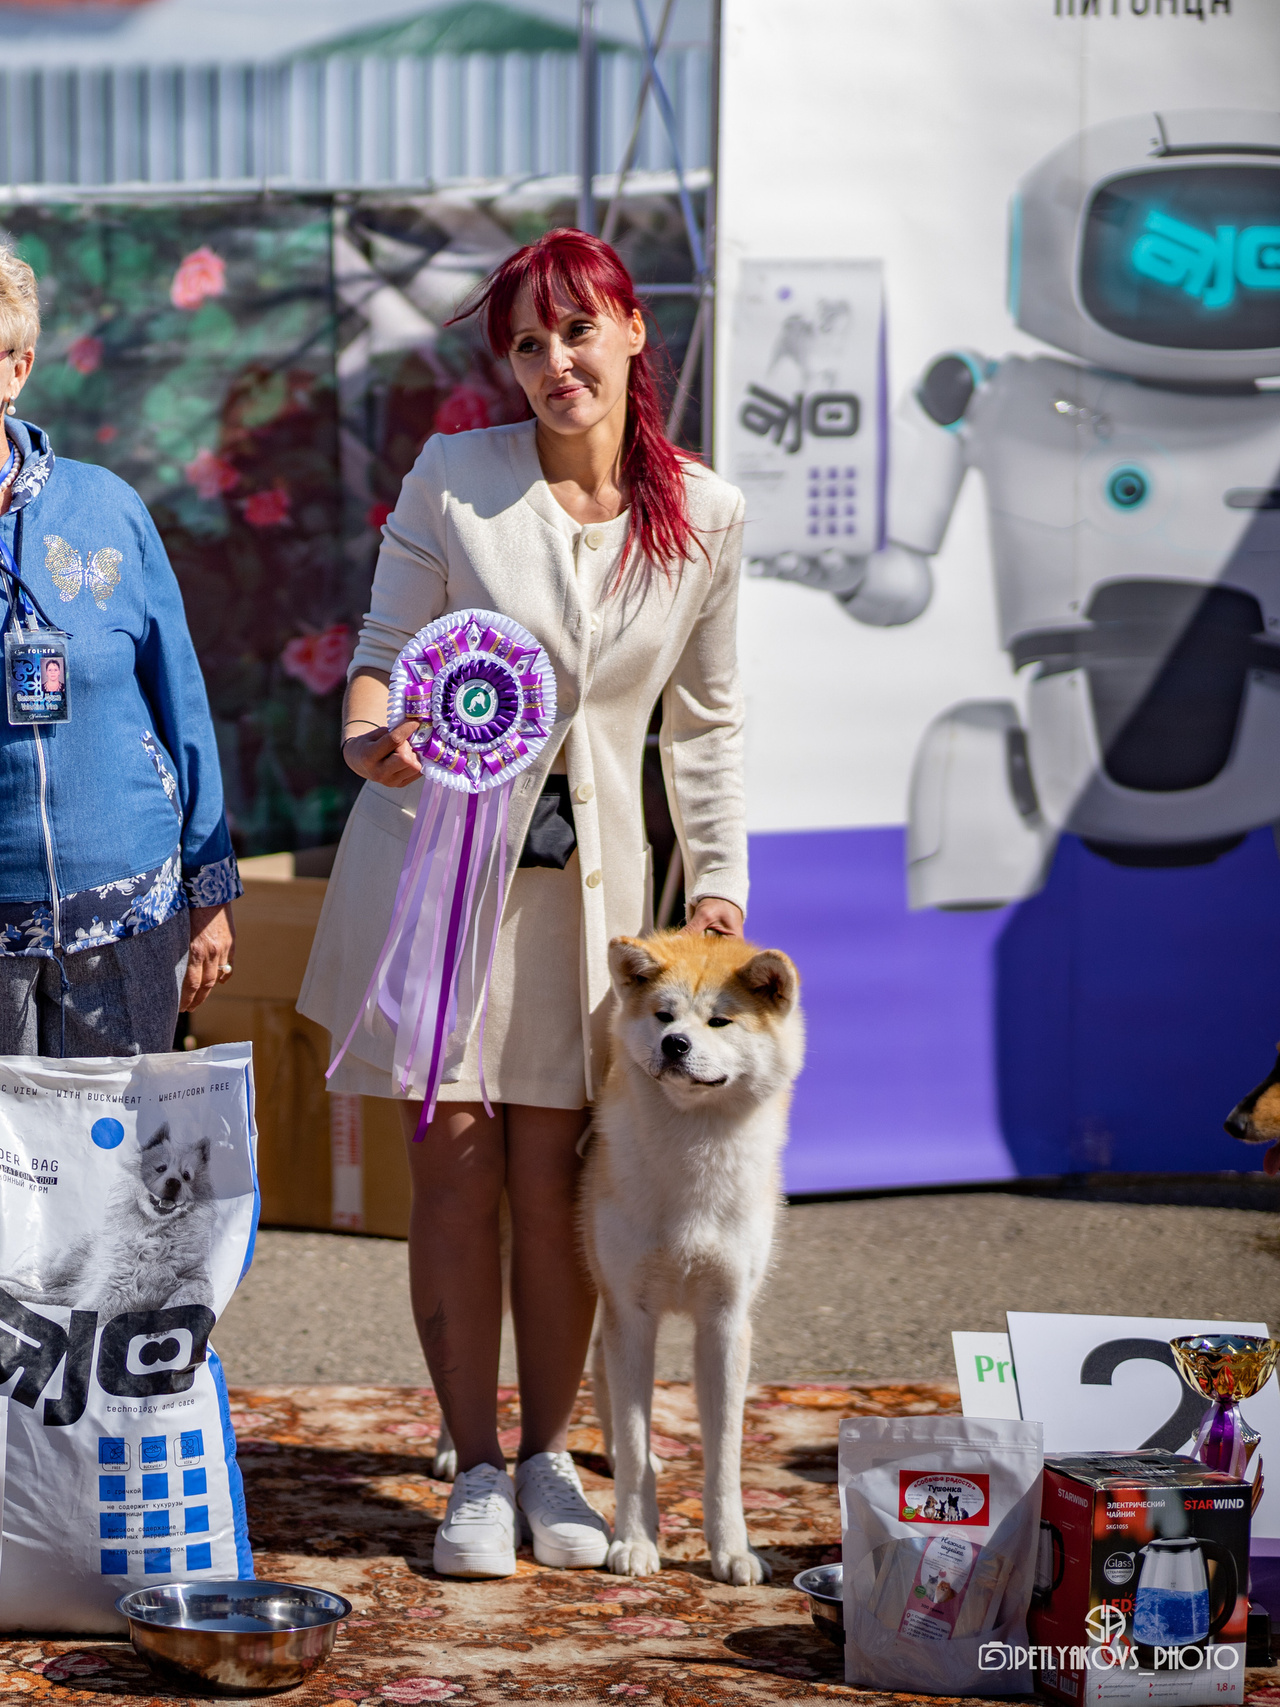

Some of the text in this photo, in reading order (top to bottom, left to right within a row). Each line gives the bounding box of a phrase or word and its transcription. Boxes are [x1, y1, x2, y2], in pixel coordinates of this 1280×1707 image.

[13, 1086, 38, 1096] VIEW
[56, 1089, 81, 1099] WITH
[87, 1092, 142, 1104] BUCKWHEAT
[158, 1086, 205, 1102] WHEAT/CORN
[210, 1082, 230, 1093] FREE
[31, 1158, 59, 1172] BAG
[1080, 1338, 1212, 1452] 2
[106, 1398, 195, 1414] technology and care
[1057, 1487, 1089, 1508] STARWIND
[152, 1501, 184, 1509] кукурузы
[1106, 1500, 1166, 1510] ЭЛЕКТРИЧЕСКИЙ
[1183, 1498, 1245, 1511] STARWIND
[1106, 1509, 1136, 1519] ЧАЙНИК
[142, 1531, 187, 1539] ингредиентов
[1107, 1559, 1132, 1569] Glass
[1216, 1683, 1228, 1692] 1,8
